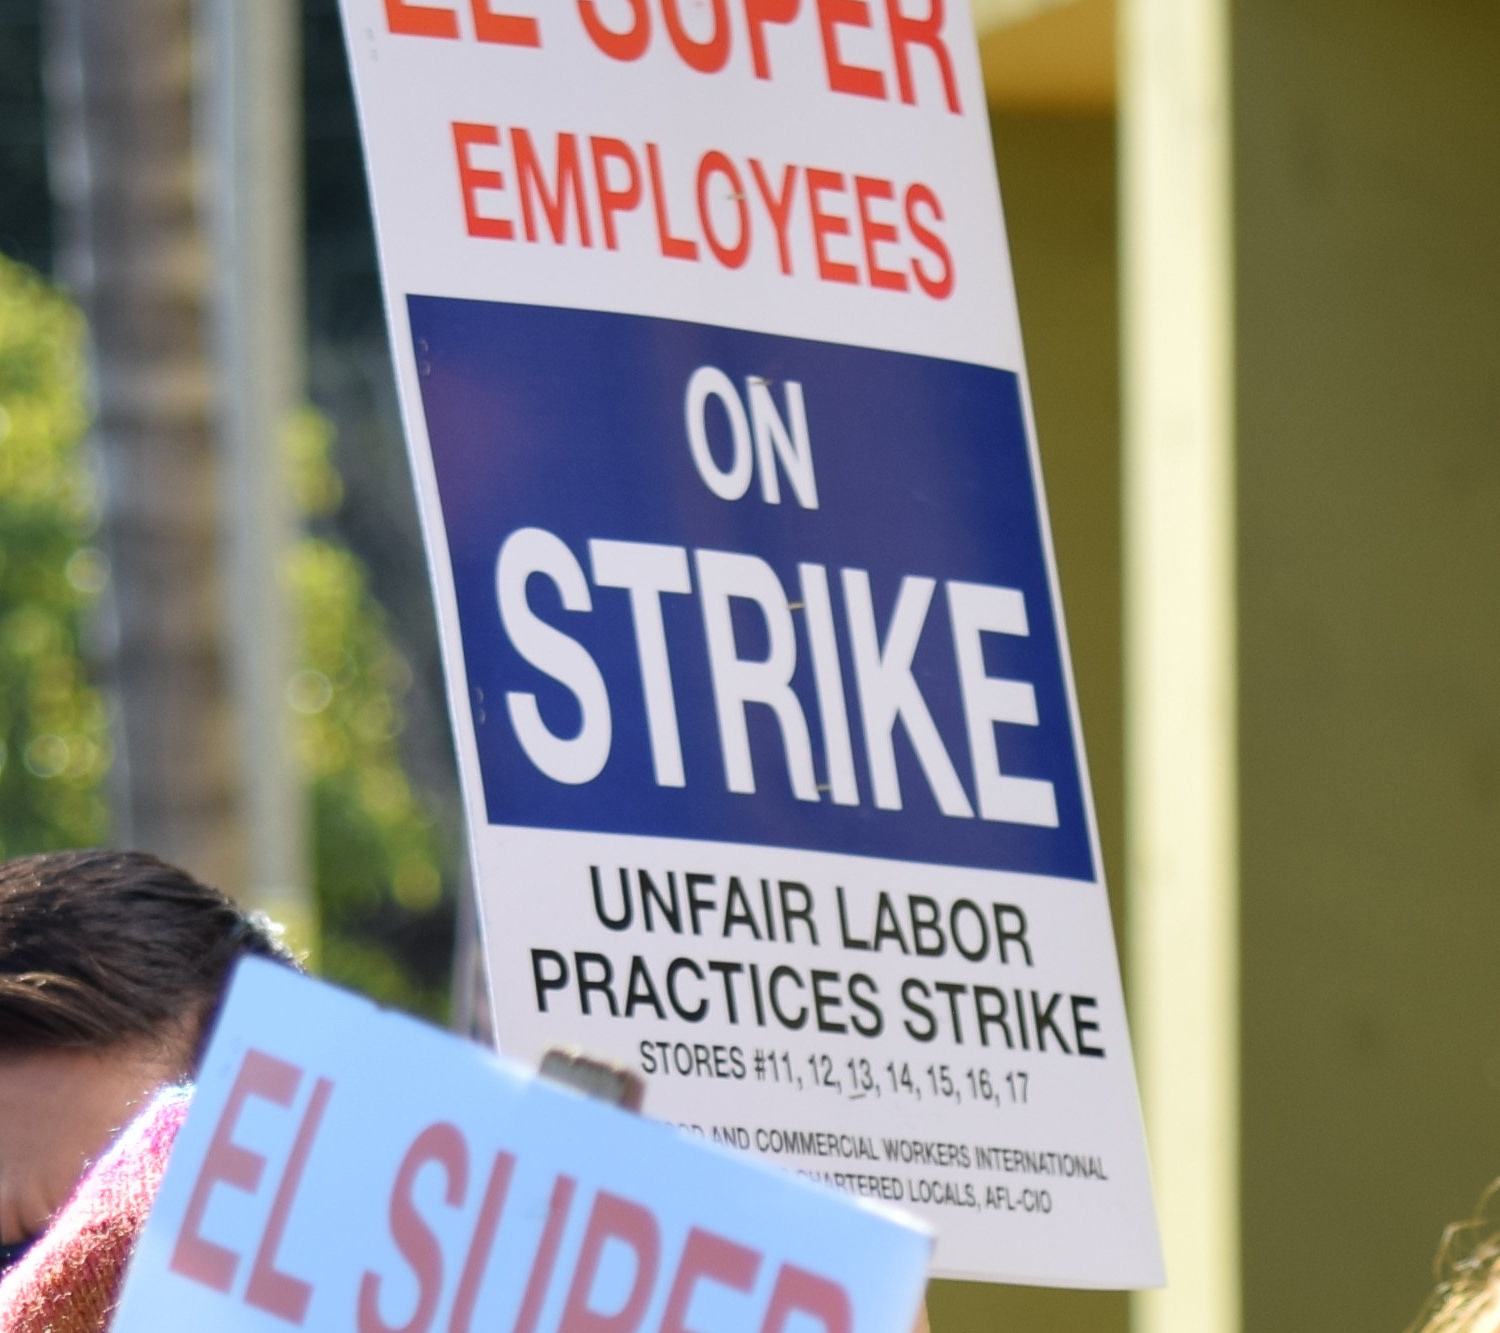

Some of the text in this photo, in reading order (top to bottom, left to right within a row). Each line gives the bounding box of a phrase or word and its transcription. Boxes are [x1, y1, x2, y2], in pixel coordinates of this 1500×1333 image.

[451, 121, 955, 301] EMPLOYEES
[685, 366, 819, 509] ON
[495, 527, 1059, 827] STRIKE
[590, 865, 1033, 966] UNFAIR LABOR
[530, 948, 1105, 1058] PRACTICES STRIKE
[639, 1040, 1029, 1106] STORES #11, 12, 13, 14, 15, 16, 17
[168, 1046, 336, 1328] EL
[755, 1128, 880, 1161] COMMERCIAL
[882, 1139, 971, 1169] WORKERS
[974, 1146, 1108, 1181] INTERNATIONAL
[908, 1179, 980, 1207] LOCALS,
[985, 1185, 1052, 1214] AFL-CIO
